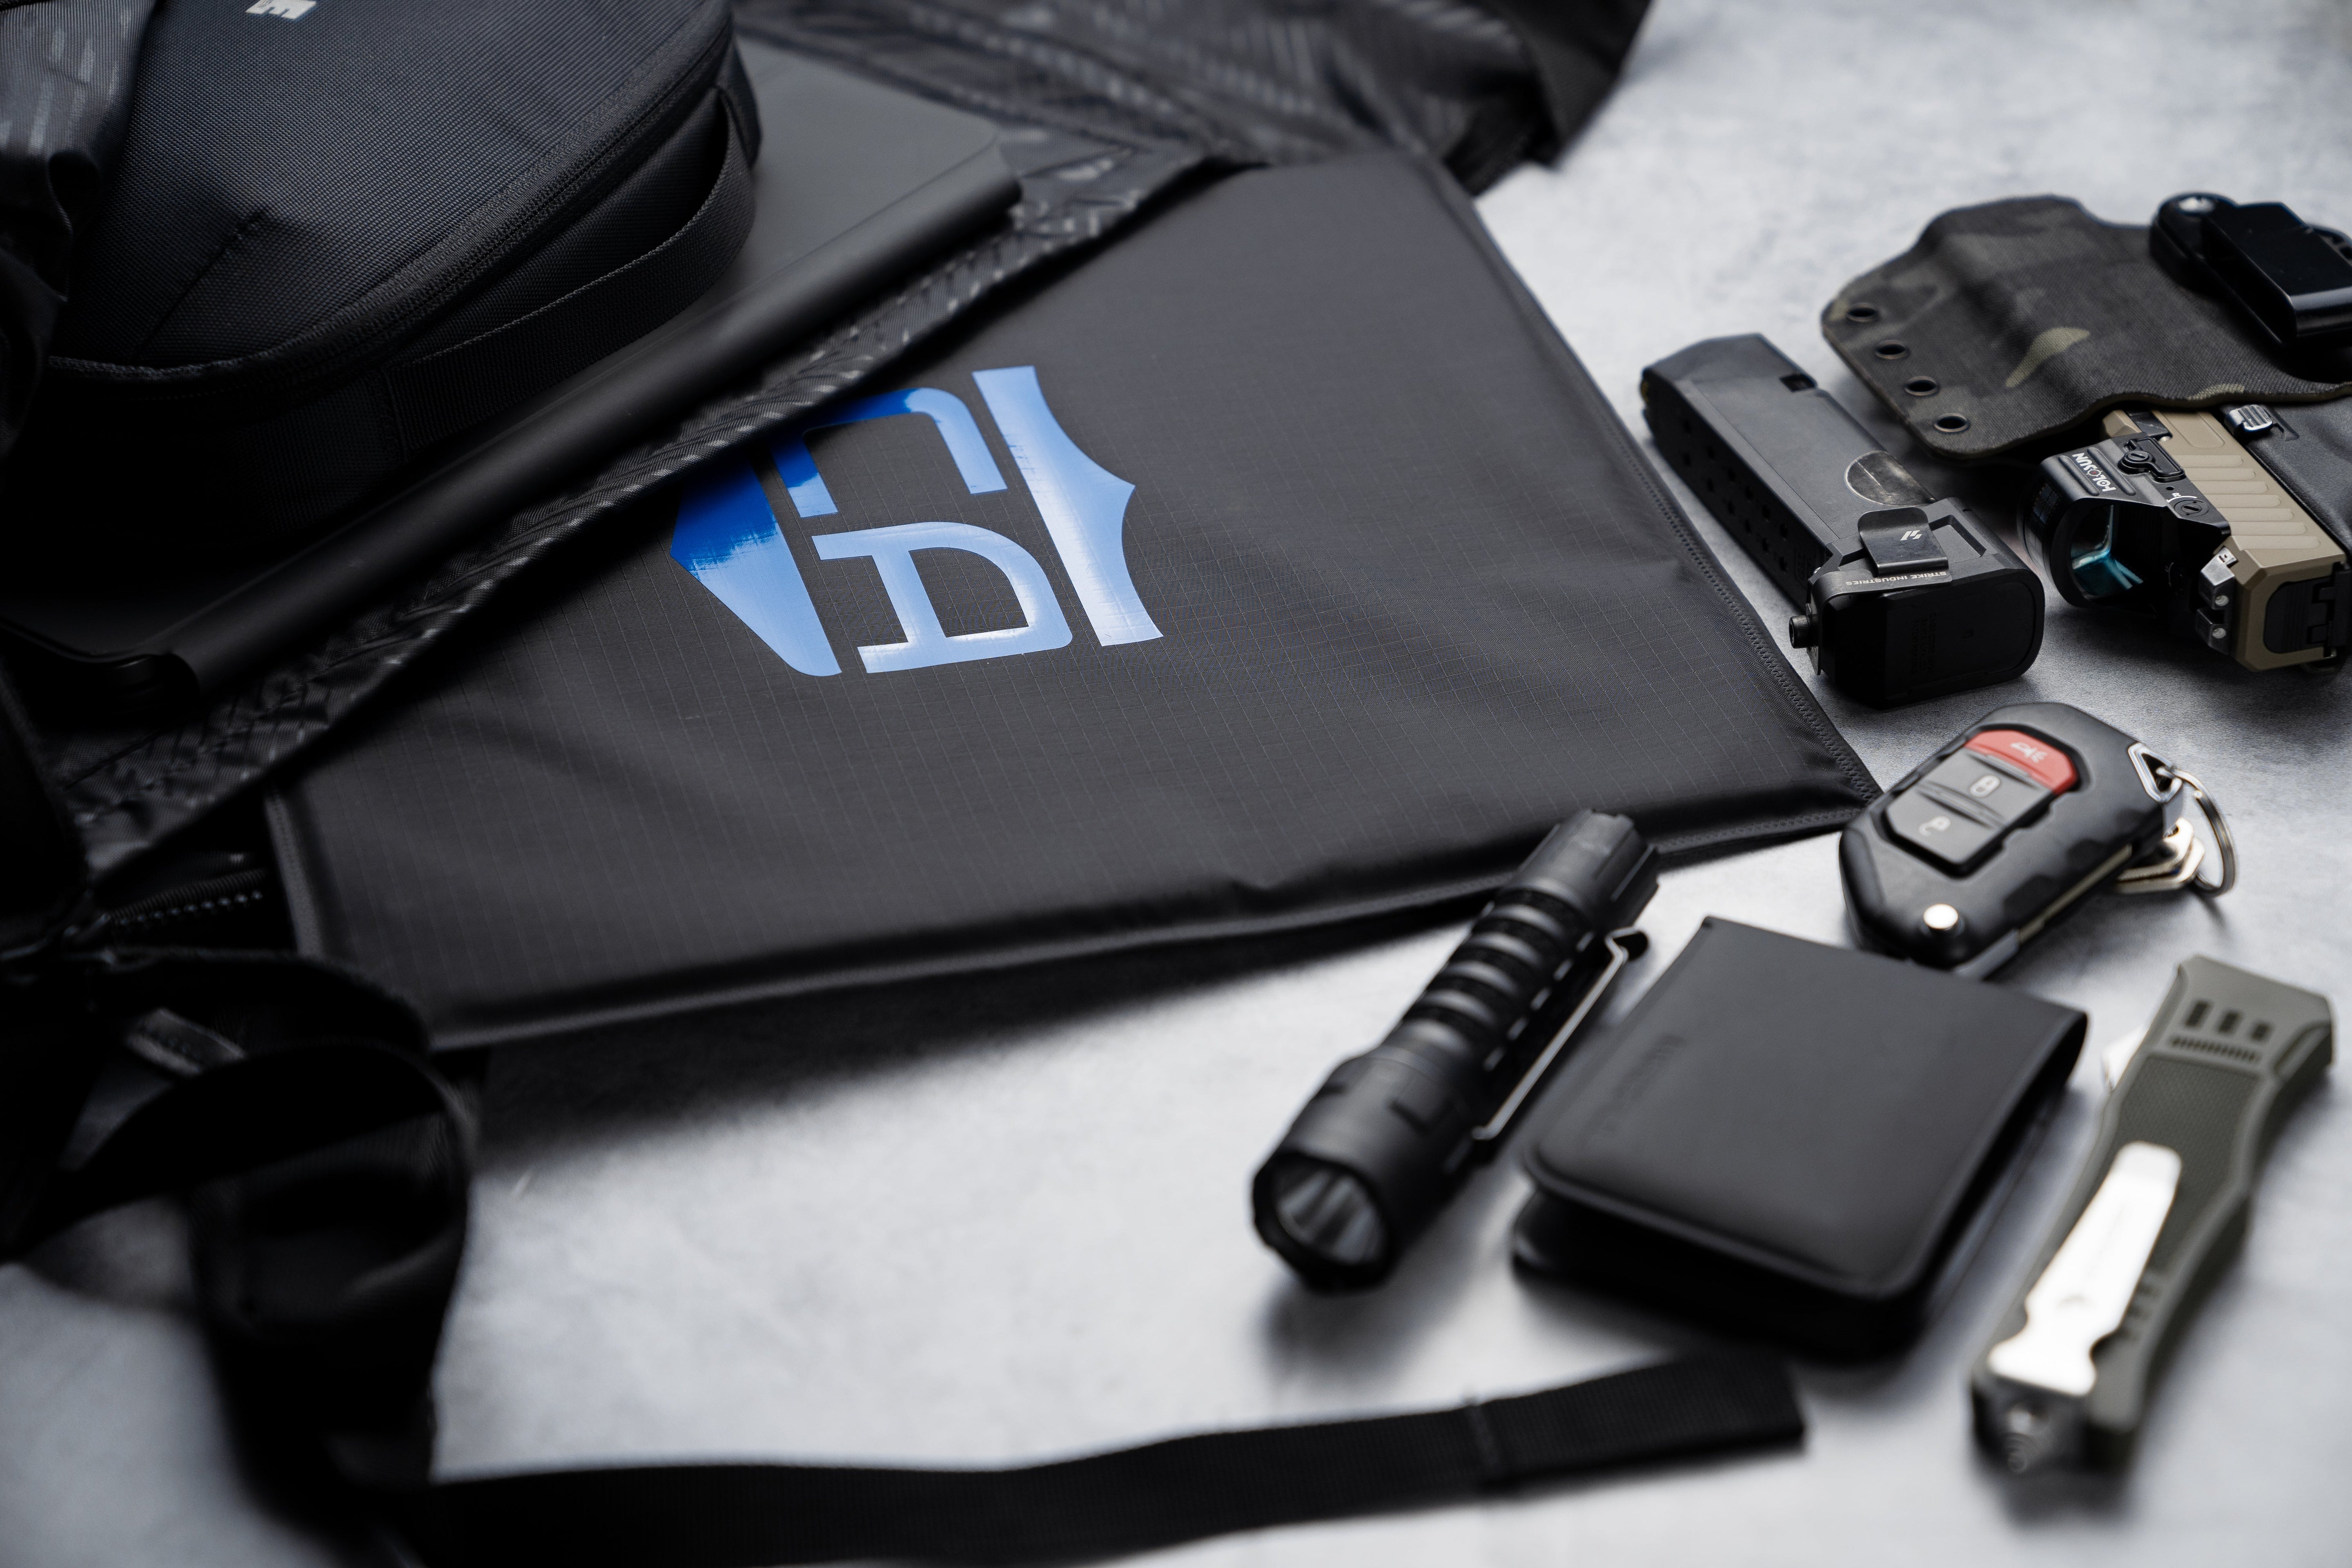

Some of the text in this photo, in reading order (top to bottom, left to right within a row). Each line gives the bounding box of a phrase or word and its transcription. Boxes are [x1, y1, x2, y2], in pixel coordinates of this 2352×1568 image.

[2071, 452, 2117, 492] HOLOSUN
[1845, 571, 1947, 586] STRIKE INDUSTRIES
